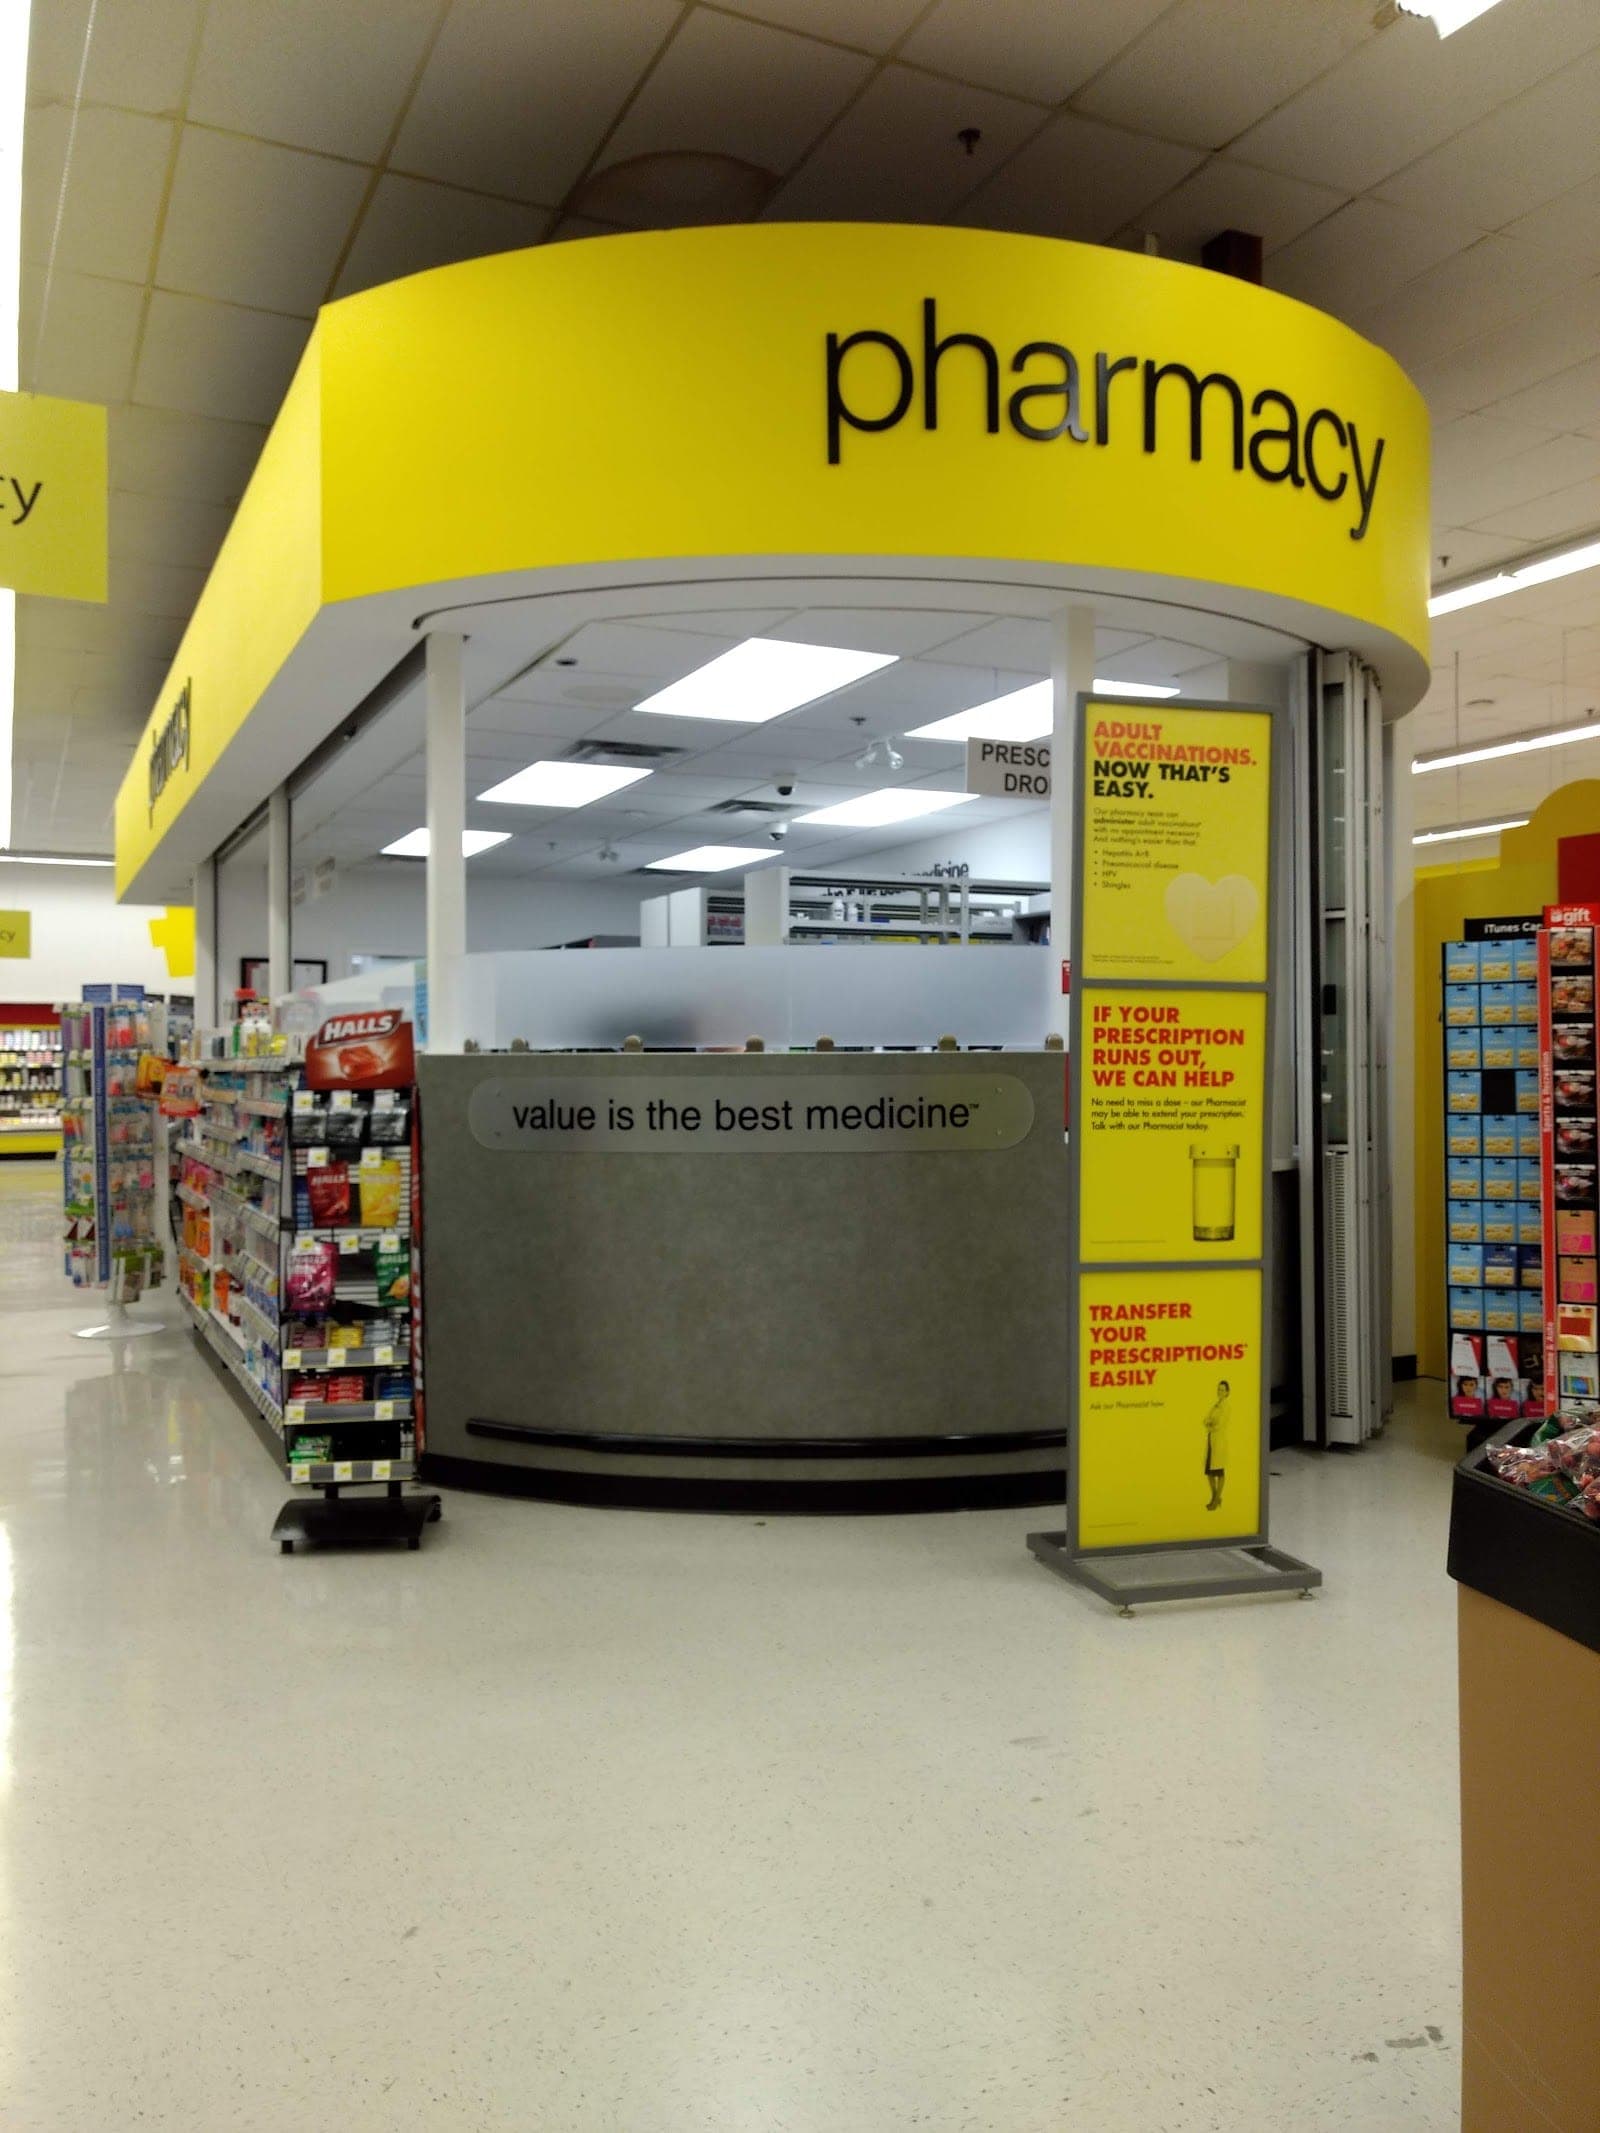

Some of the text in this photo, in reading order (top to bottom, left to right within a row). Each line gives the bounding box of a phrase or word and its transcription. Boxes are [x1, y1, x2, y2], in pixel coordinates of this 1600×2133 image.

[826, 297, 1385, 540] pharmacy
[1093, 721, 1163, 741] ADULT
[981, 743, 1050, 767] PRESC
[1093, 740, 1257, 766] VACCINATIONS.
[1093, 760, 1231, 783] NOW THAT'S
[1004, 773, 1048, 795] DRO
[1093, 780, 1154, 799] EASY.
[1563, 907, 1591, 926] gift
[1483, 923, 1520, 934] iTunes
[1093, 1006, 1180, 1023] IF YOUR
[324, 1015, 394, 1042] HALLS
[1093, 1027, 1245, 1045] PRESCRIPTION
[1093, 1049, 1206, 1069] RUNS OUT,
[1092, 1070, 1235, 1087] WE CAN HELP
[1091, 1098, 1103, 1107] No
[1106, 1098, 1124, 1107] need
[1137, 1098, 1152, 1107] miss
[1163, 1098, 1181, 1107] dose
[1206, 1098, 1247, 1107] Pharmacist
[513, 1098, 596, 1130] value
[608, 1099, 634, 1130] is
[646, 1100, 701, 1130] the
[715, 1099, 793, 1131] best
[1091, 1111, 1108, 1120] may
[1111, 1109, 1120, 1117] be
[1123, 1109, 1139, 1117] able
[1142, 1109, 1149, 1117] to
[1152, 1109, 1178, 1117] extend
[1180, 1111, 1197, 1120] your
[1092, 1121, 1106, 1130] Talk
[1109, 1121, 1125, 1130] with
[1144, 1121, 1184, 1130] Pharmacist
[1089, 1303, 1193, 1321] TRANSFER
[1090, 1326, 1147, 1343] YOUR
[1089, 1369, 1157, 1387] EASILY
